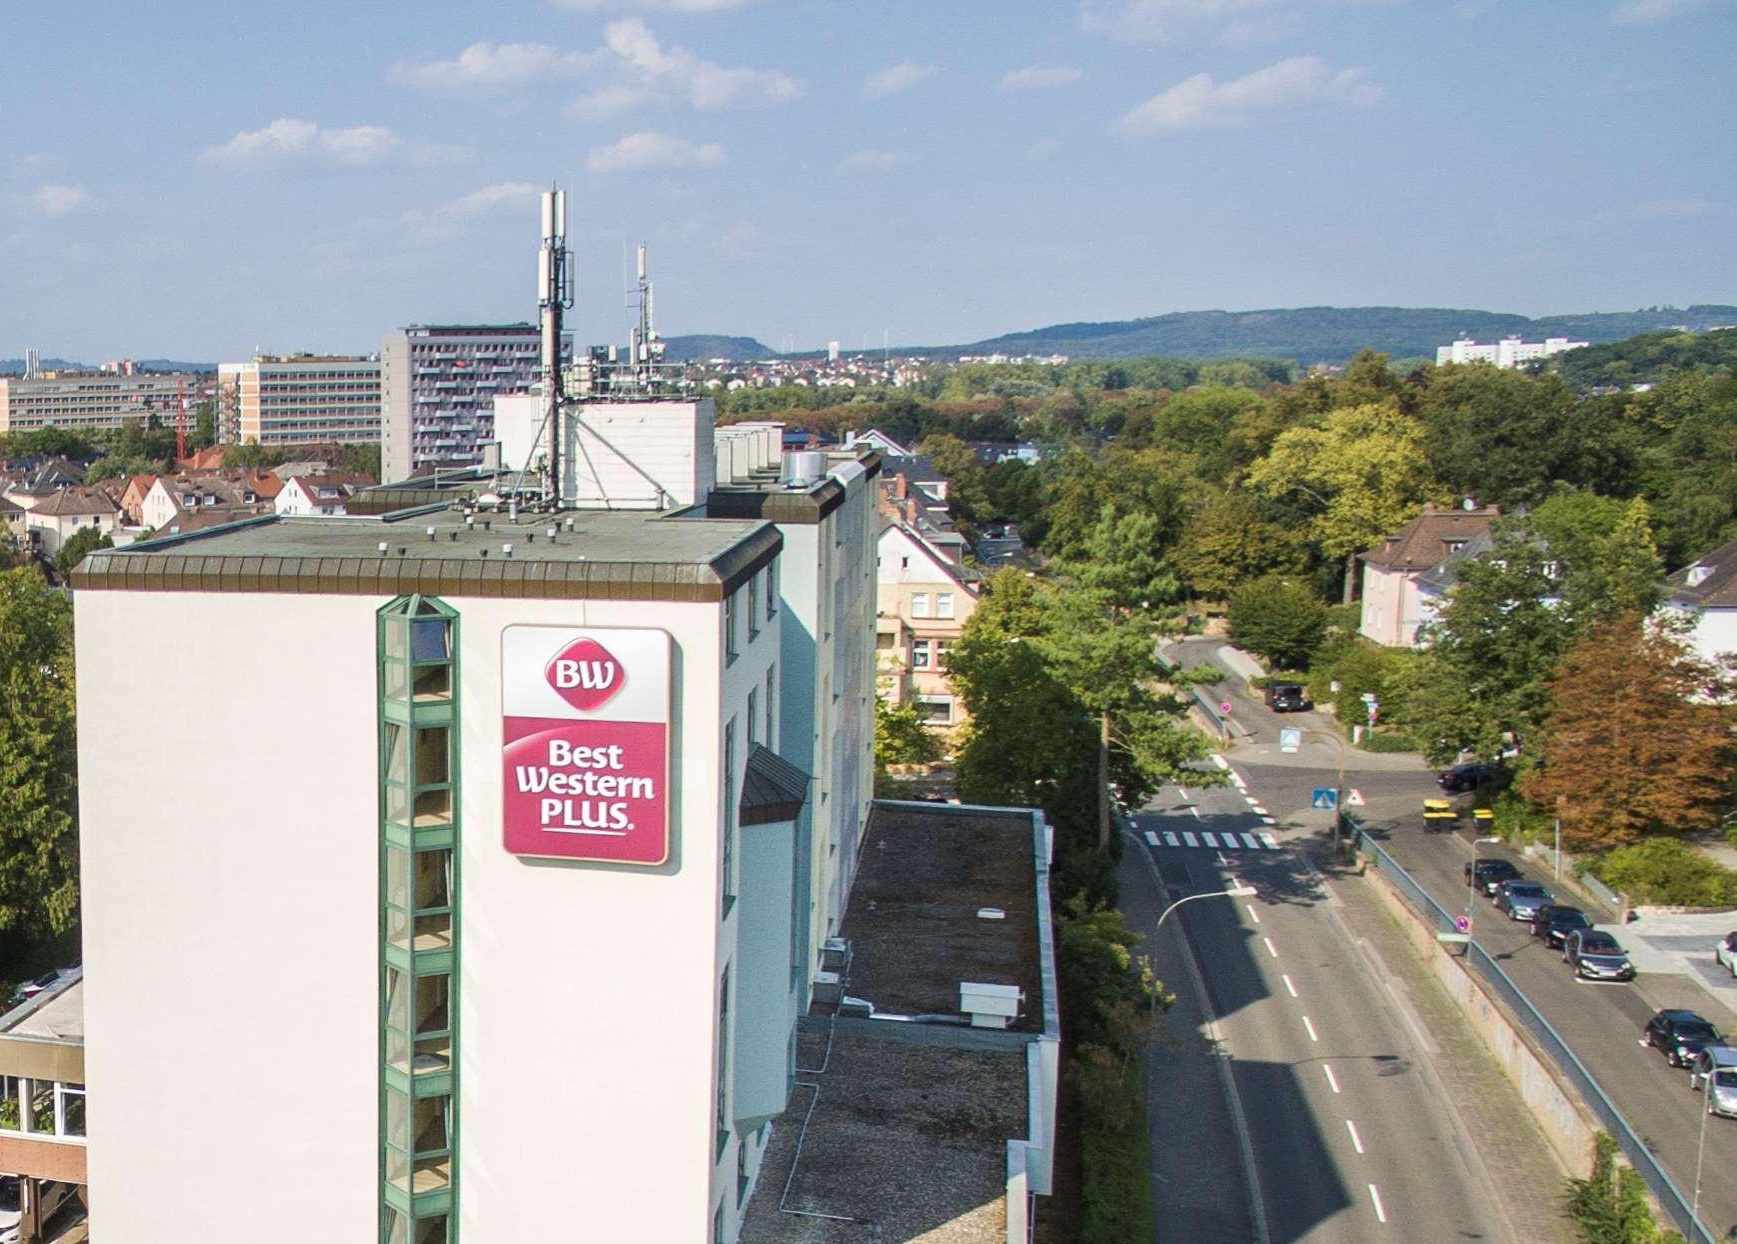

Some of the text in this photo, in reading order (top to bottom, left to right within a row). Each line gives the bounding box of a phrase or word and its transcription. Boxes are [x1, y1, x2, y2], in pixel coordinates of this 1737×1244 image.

[556, 659, 614, 690] BW
[549, 739, 623, 770] Best
[516, 766, 655, 799] Western
